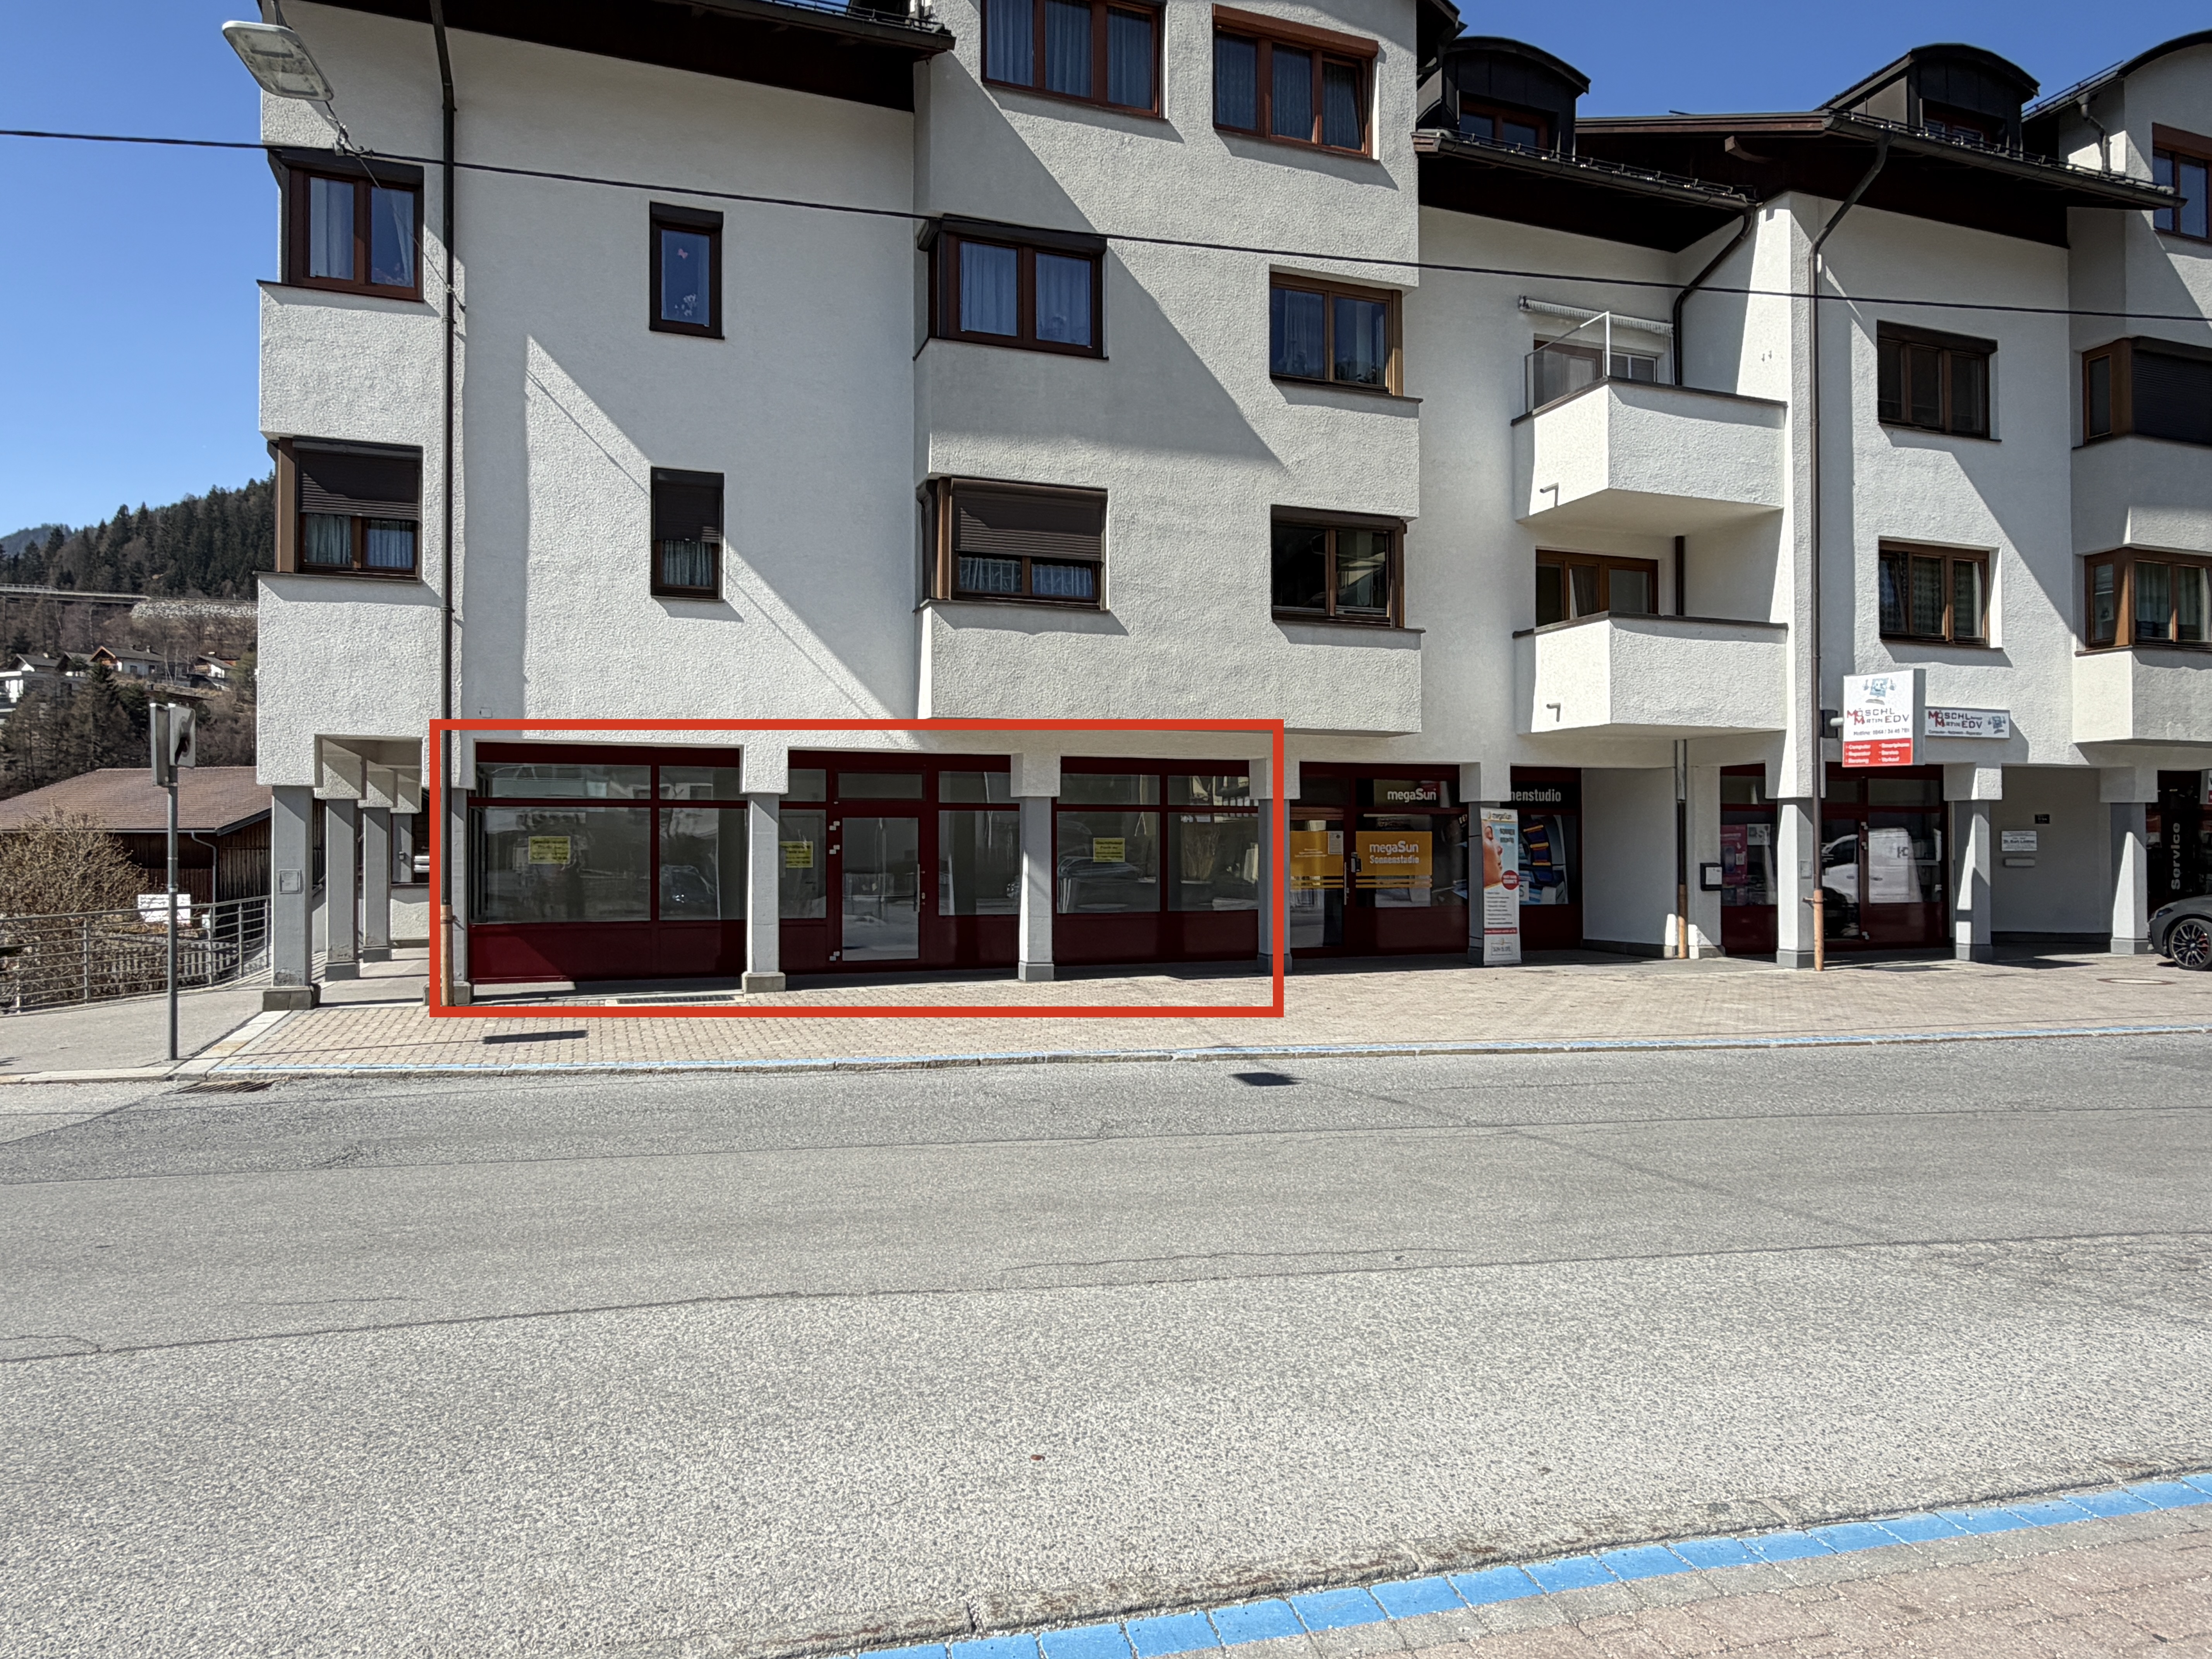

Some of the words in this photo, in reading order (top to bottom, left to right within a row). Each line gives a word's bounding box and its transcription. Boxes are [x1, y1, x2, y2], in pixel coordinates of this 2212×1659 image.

[1885, 714, 1910, 723] EDV
[1961, 720, 1982, 728] EDV
[1387, 788, 1436, 803] megaSun
[1369, 840, 1419, 855] megaSun
[1369, 855, 1419, 864] Sonnenstudio
